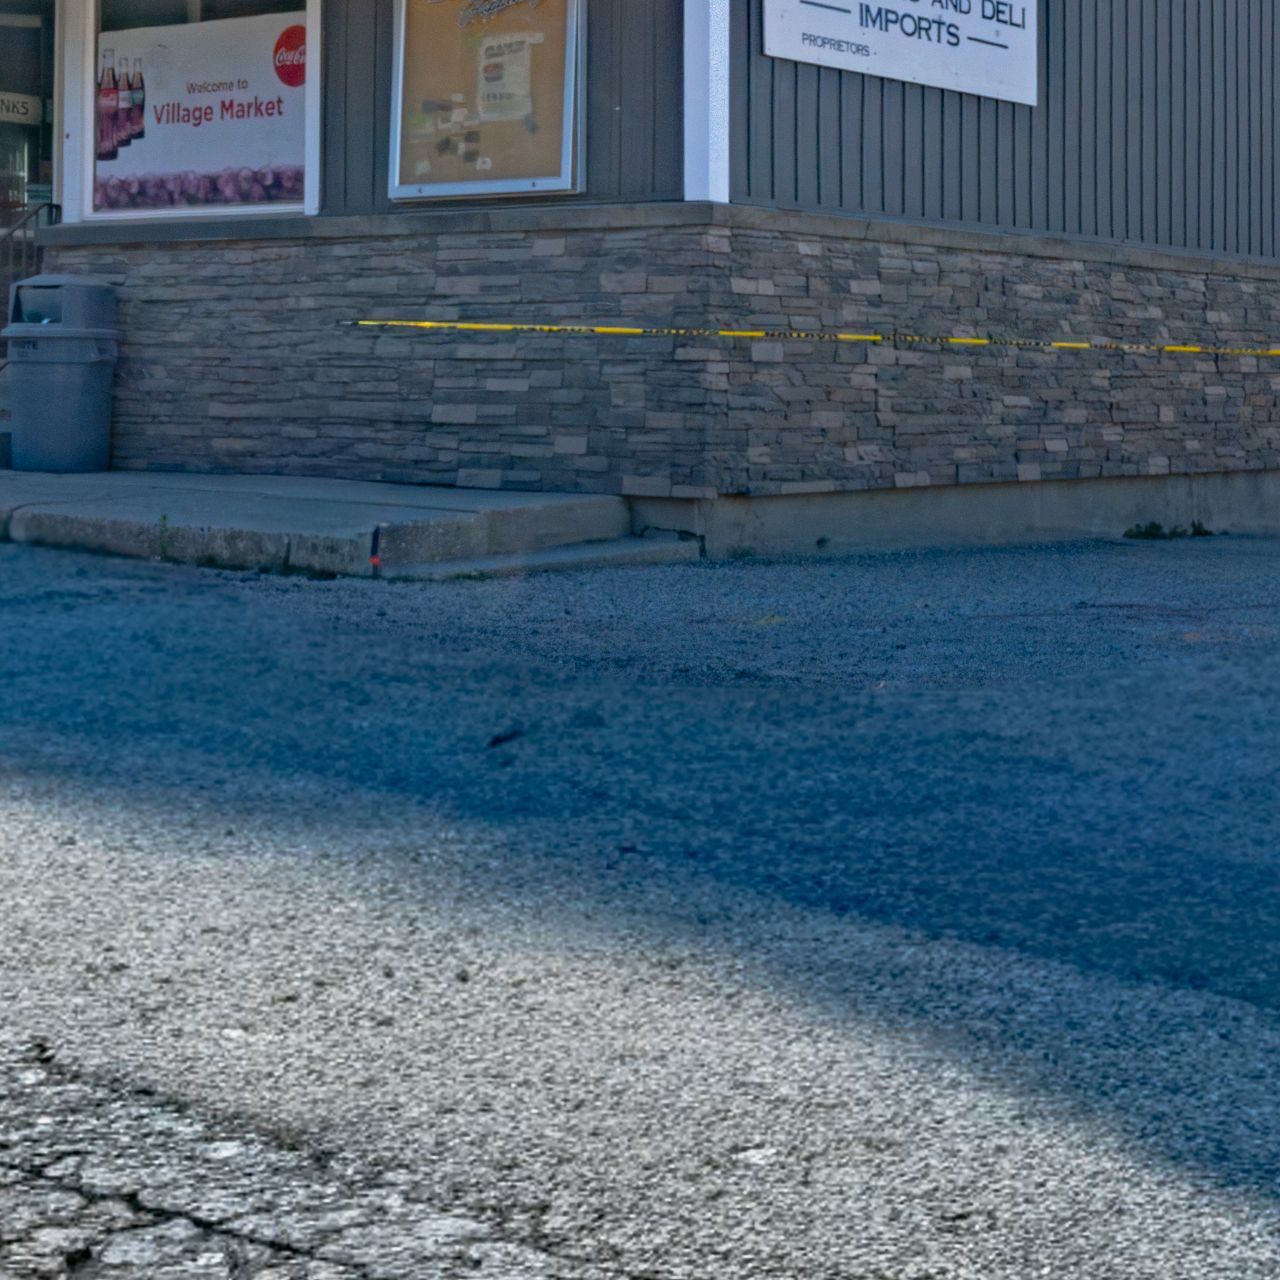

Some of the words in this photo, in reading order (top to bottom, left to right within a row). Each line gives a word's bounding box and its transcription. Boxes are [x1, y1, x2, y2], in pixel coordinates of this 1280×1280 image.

[859, 2, 961, 47] IMPORTS
[802, 32, 870, 57] PROPRIETORS
[186, 80, 234, 95] Welcome
[237, 78, 249, 90] to
[153, 102, 214, 127] Village
[221, 96, 284, 120] Market
